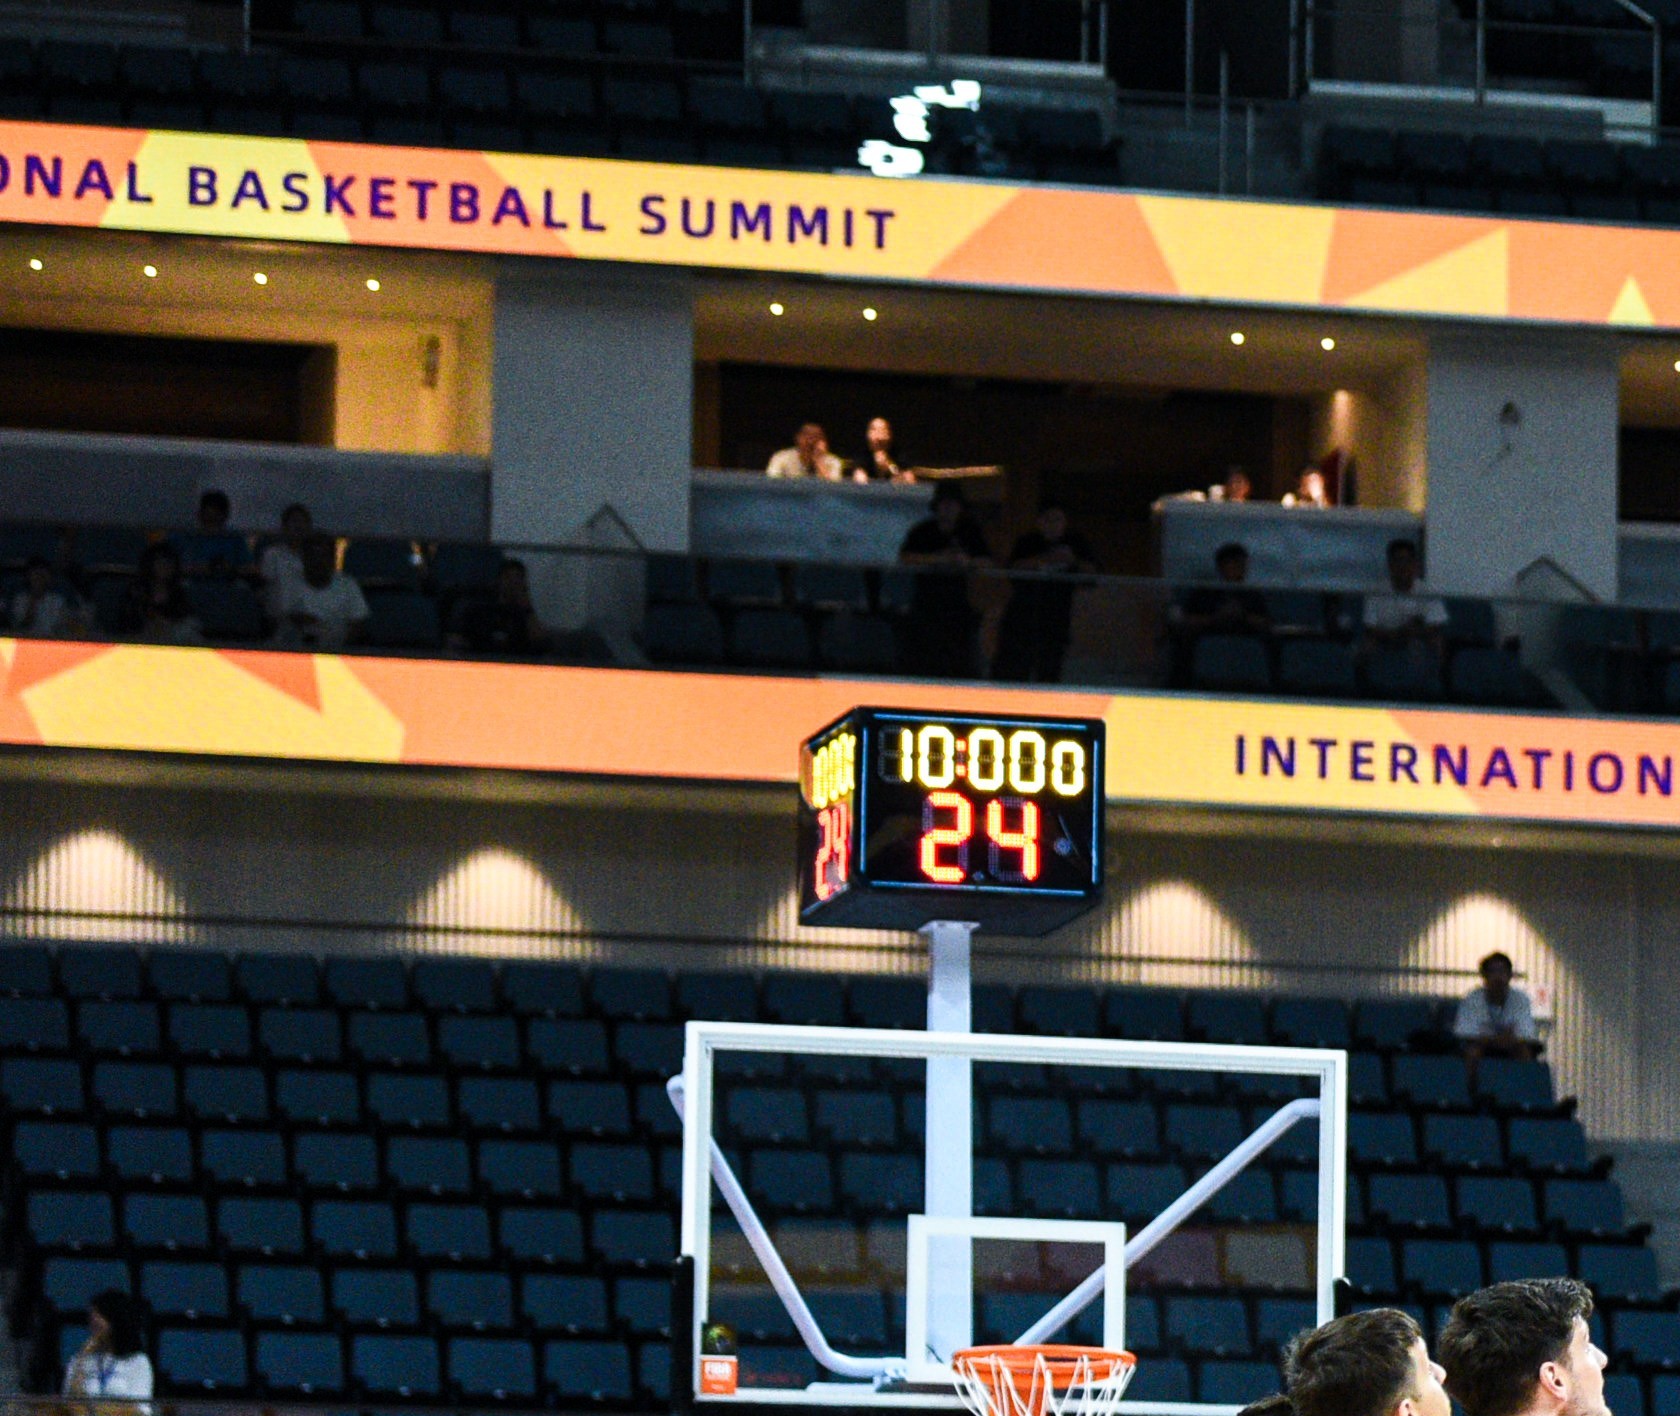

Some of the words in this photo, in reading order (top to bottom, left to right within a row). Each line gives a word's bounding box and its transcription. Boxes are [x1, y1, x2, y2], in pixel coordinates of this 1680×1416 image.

[0, 152, 153, 203] NAL
[188, 166, 606, 232] BASKETBALL
[639, 195, 895, 249] SUMMIT
[815, 803, 848, 900] 24
[921, 791, 1039, 884] 24
